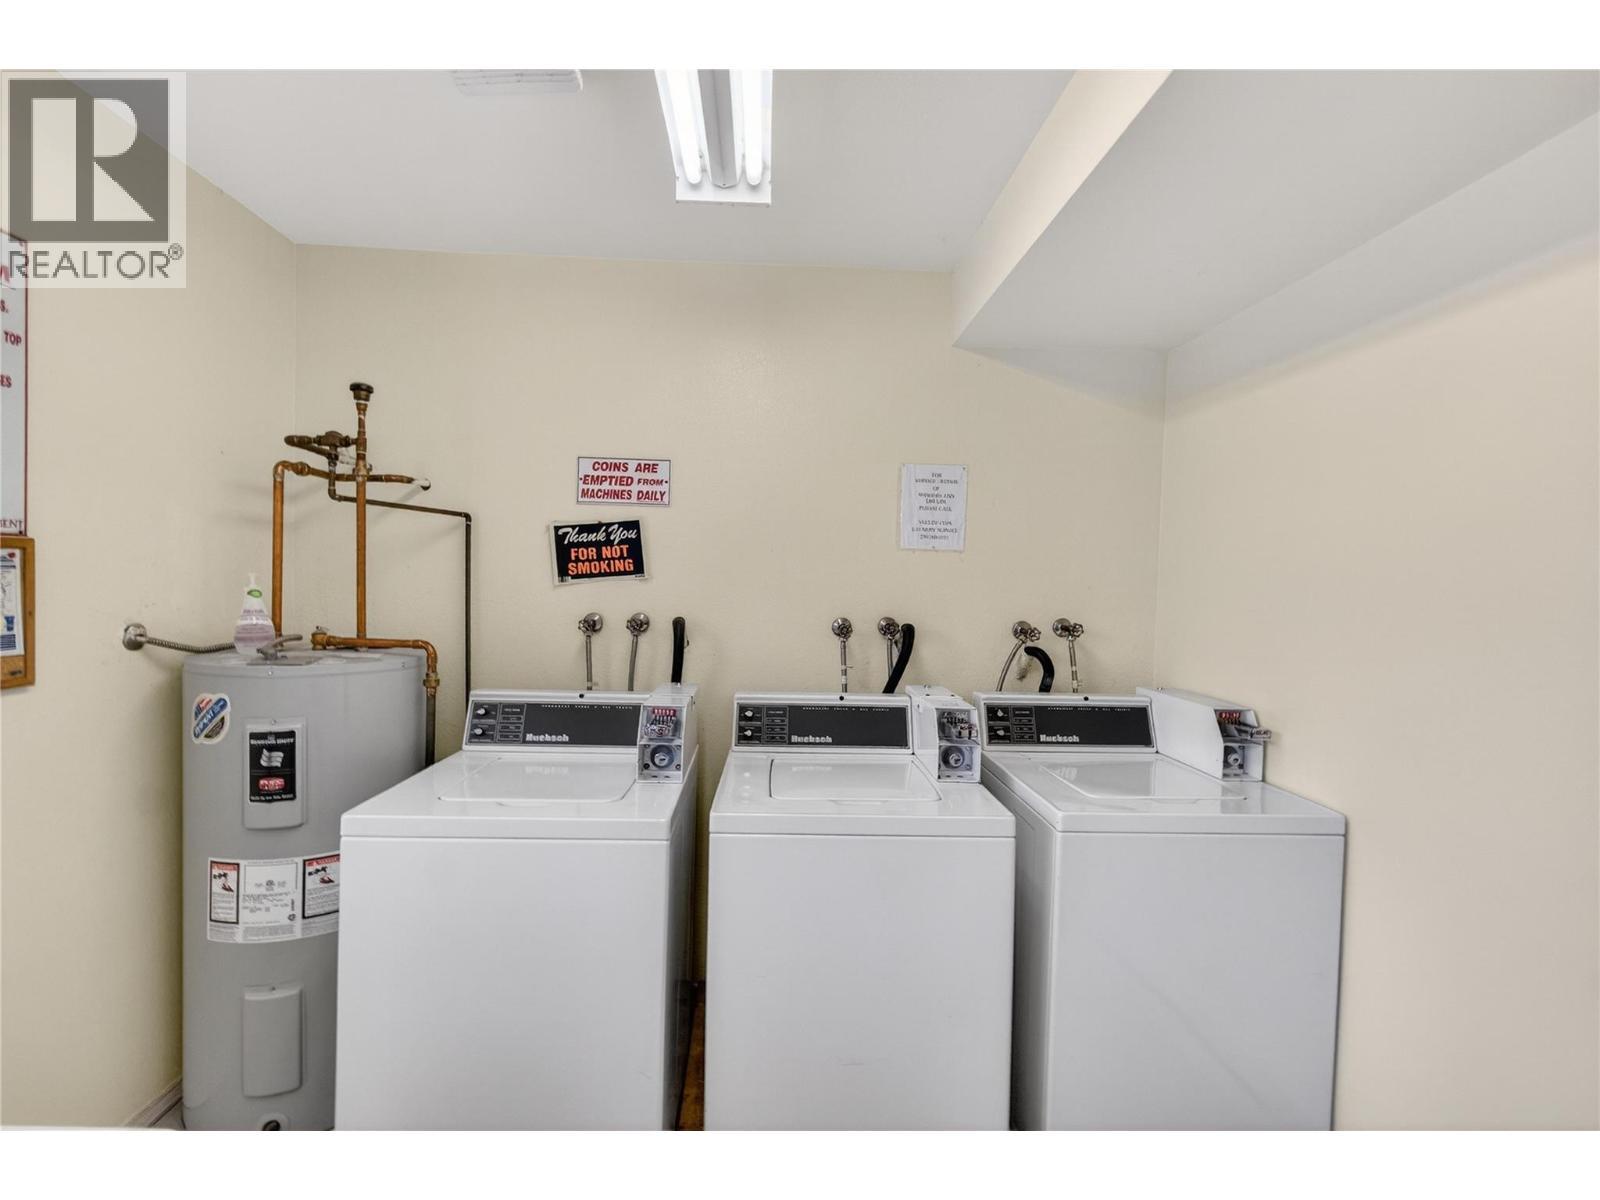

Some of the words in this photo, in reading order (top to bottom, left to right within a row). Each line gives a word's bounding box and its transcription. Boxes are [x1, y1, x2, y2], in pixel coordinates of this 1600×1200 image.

[4, 330, 22, 346] TOP
[592, 461, 629, 472] COINS
[635, 463, 659, 473] ARE
[582, 475, 634, 486] EMPTIED
[637, 478, 664, 486] FROM
[581, 488, 632, 500] MACHINES
[636, 490, 666, 501] DAILY
[558, 526, 606, 544] Thank
[608, 524, 637, 544] You
[570, 547, 597, 560] FOR
[602, 545, 629, 559] NOT
[568, 559, 634, 575] SMOKING
